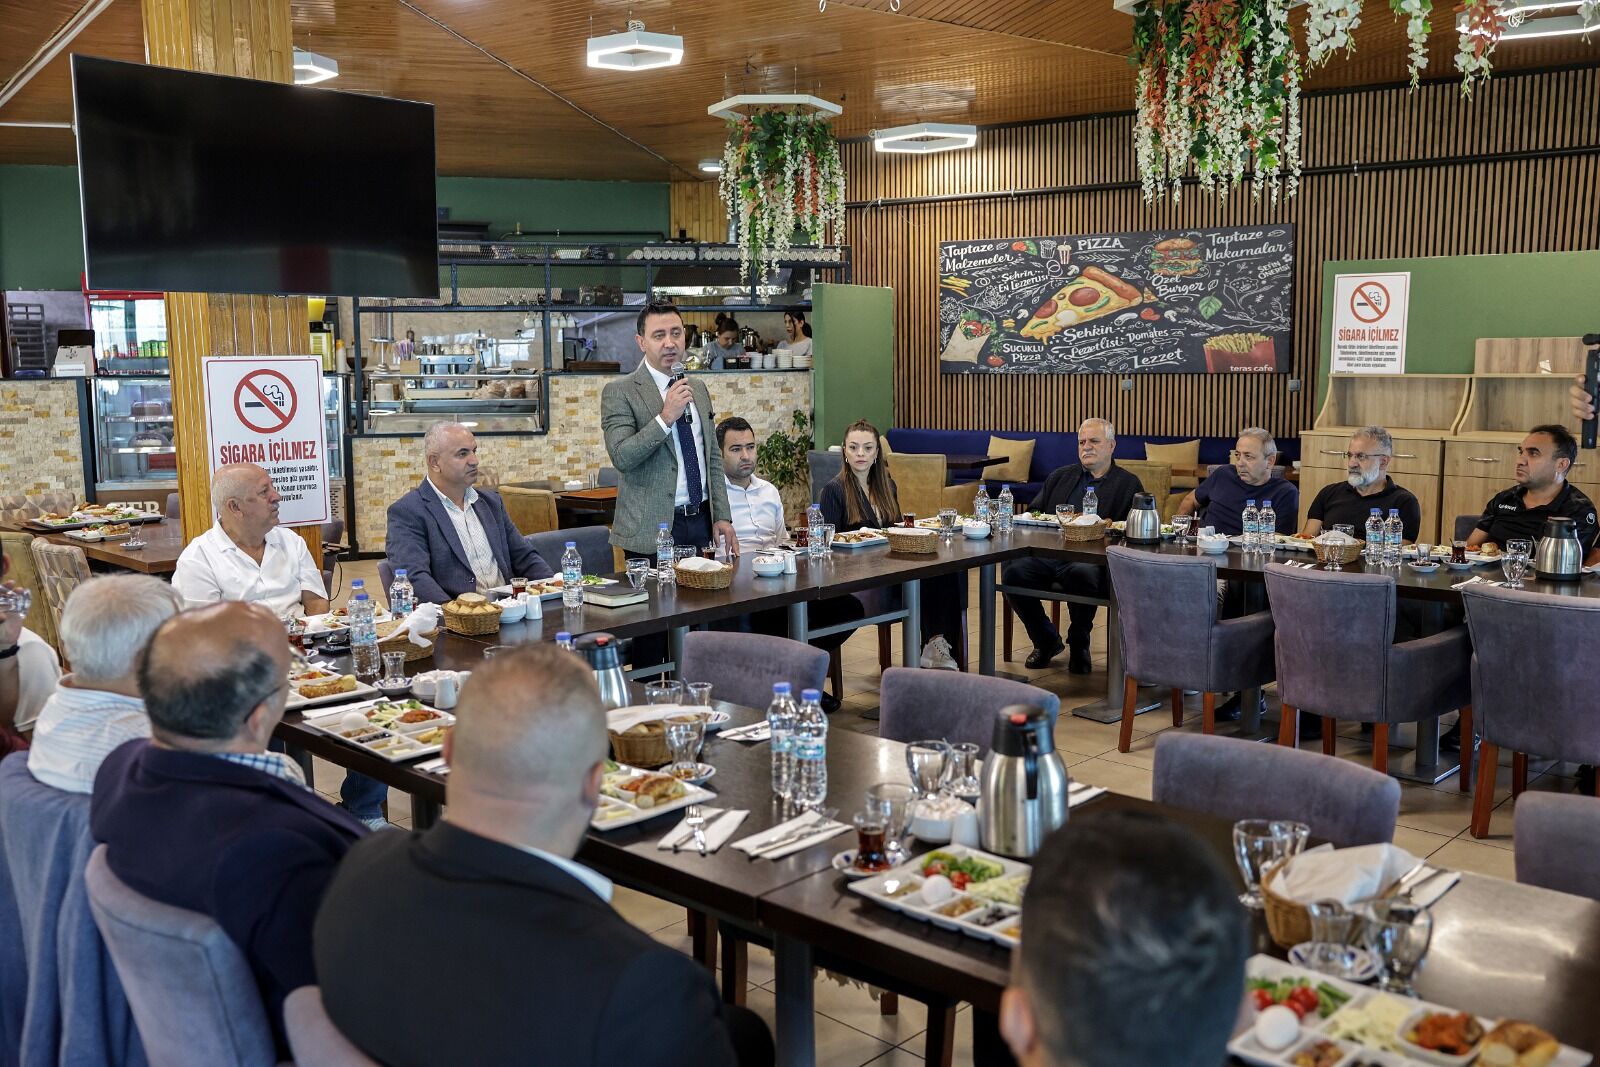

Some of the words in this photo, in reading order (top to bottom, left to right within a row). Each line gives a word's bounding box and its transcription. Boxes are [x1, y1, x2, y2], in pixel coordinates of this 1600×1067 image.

[1077, 237, 1125, 250] PIZZA
[1206, 230, 1264, 250] Taptaze
[944, 243, 995, 259] Taptaze
[1205, 242, 1287, 261] Makarnalar
[945, 253, 1014, 272] Malzemeler
[1156, 281, 1204, 296] Burger
[1126, 329, 1169, 342] Domates
[1338, 326, 1366, 341] SİGARA
[1368, 326, 1399, 342] İÇİLMEZ
[1012, 353, 1041, 362] Pizza
[220, 441, 265, 464] SİGARA
[269, 438, 317, 464] İÇİLMEZ
